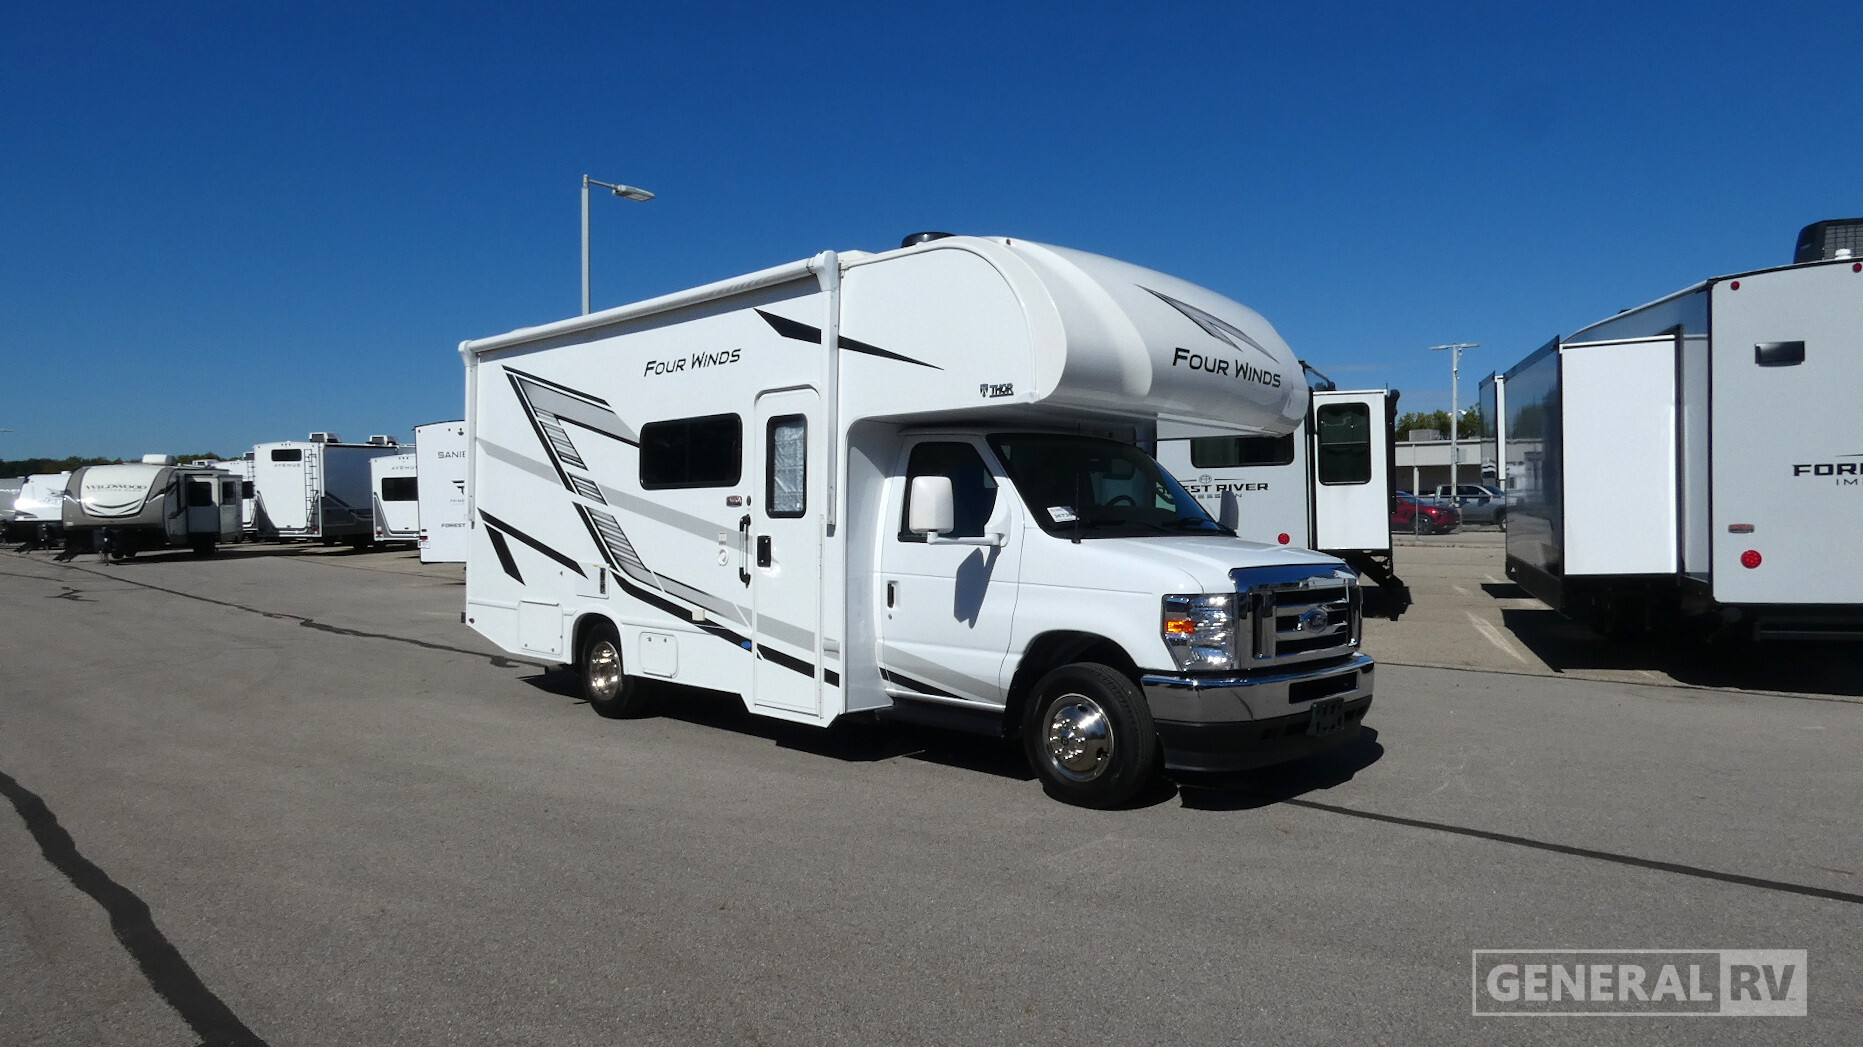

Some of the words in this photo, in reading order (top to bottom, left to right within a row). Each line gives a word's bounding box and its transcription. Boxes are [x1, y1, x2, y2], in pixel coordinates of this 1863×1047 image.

[644, 358, 687, 377] FOUR
[691, 348, 742, 369] WINDS
[1172, 347, 1229, 376] FOUR
[1235, 360, 1281, 388] WINDS
[989, 383, 1014, 397] THOR
[1792, 463, 1863, 477] FOR
[1216, 483, 1269, 491] RIVER
